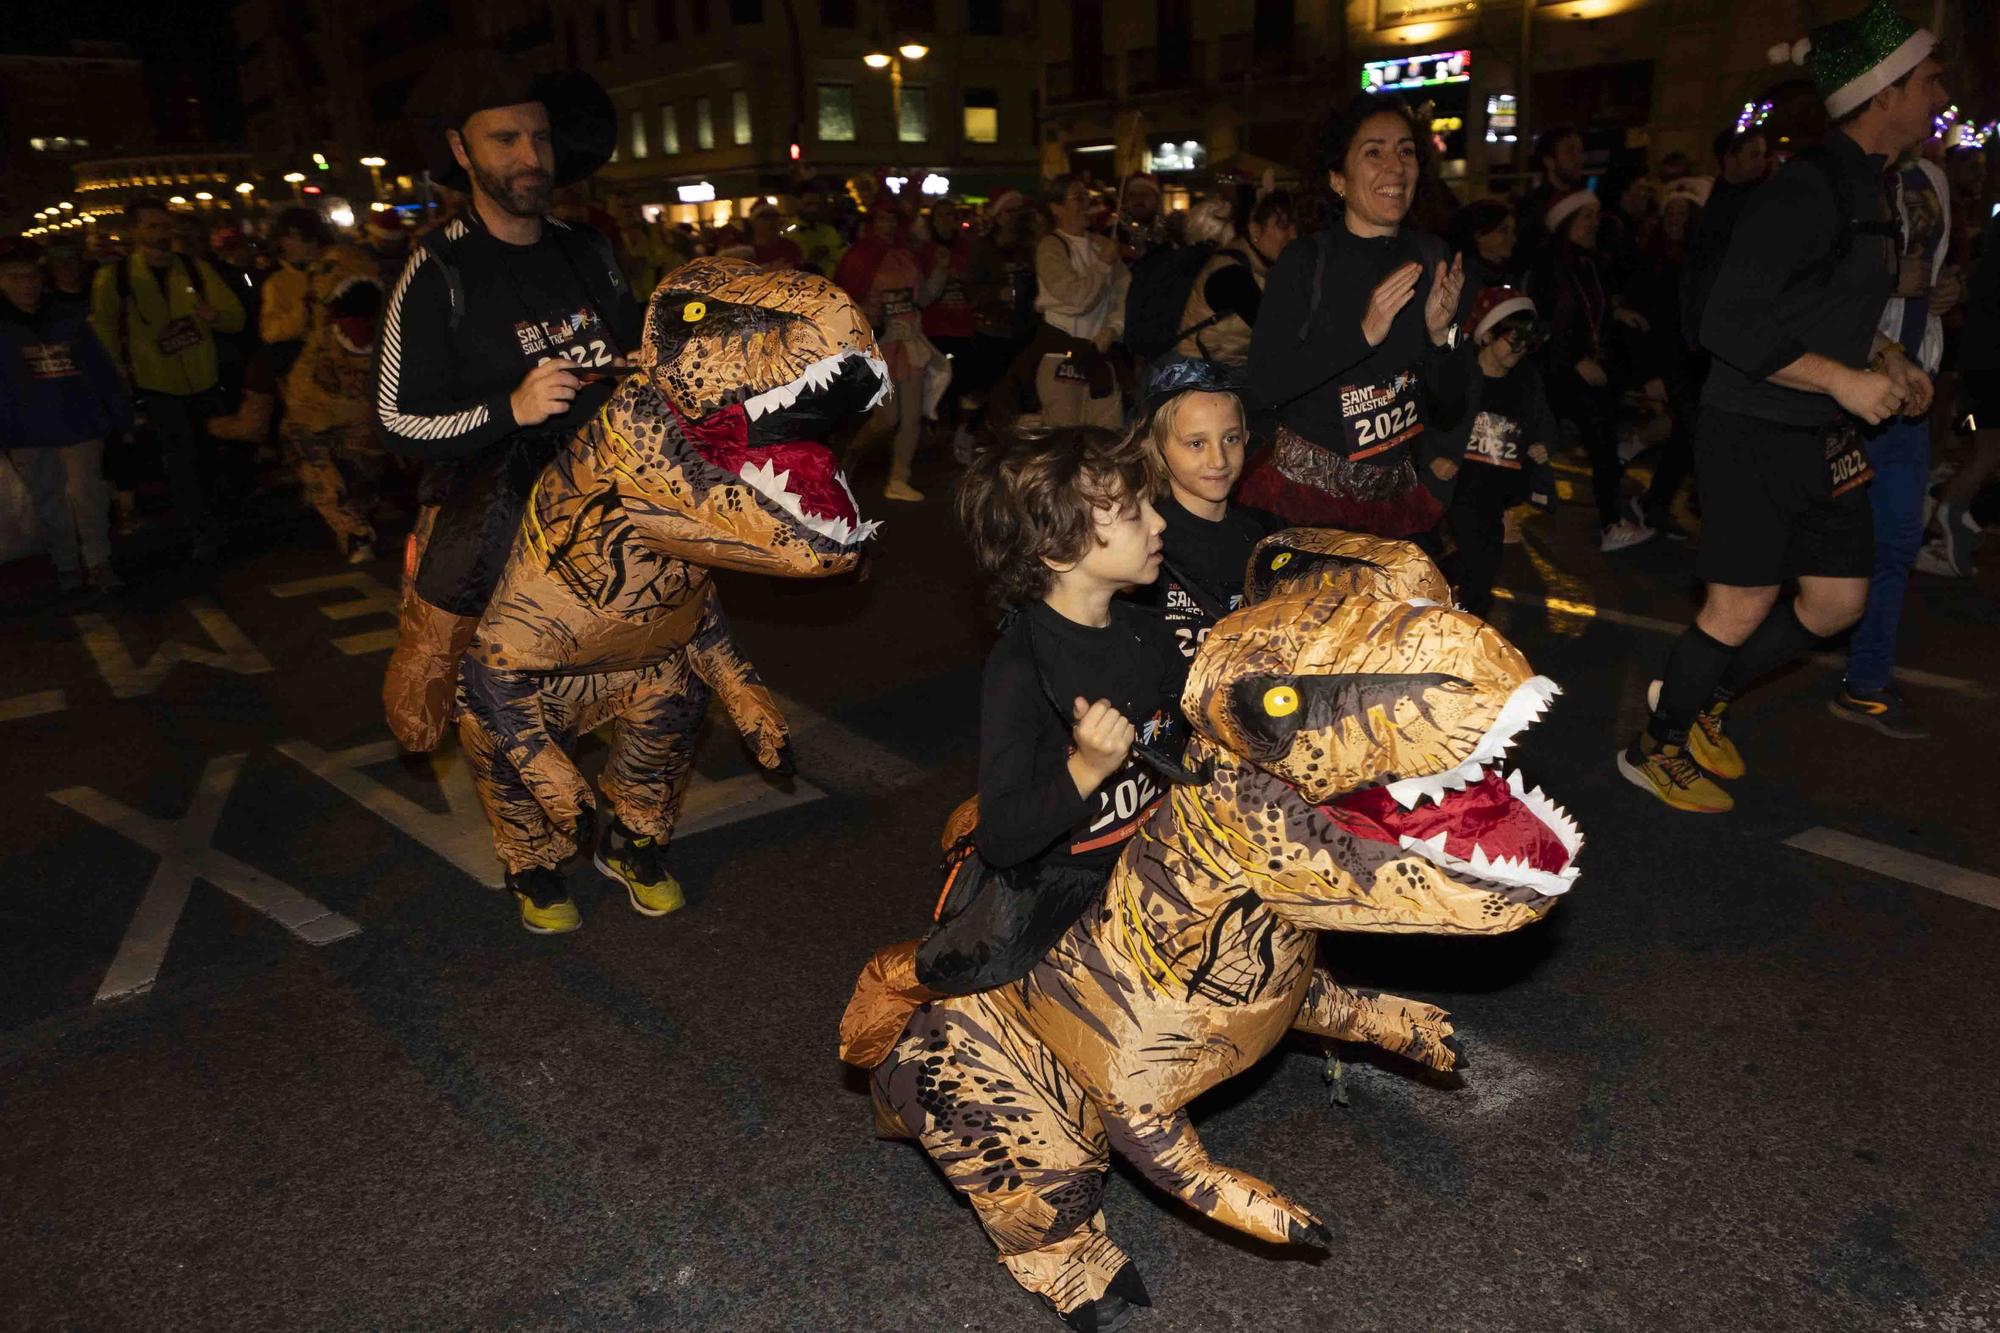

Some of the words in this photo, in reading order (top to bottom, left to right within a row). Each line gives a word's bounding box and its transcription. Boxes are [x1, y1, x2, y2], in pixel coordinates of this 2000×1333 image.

[1341, 385, 1376, 407] SANT
[1355, 401, 1418, 447] 2022
[1466, 435, 1518, 460] 2022
[1830, 449, 1868, 486] 2022
[1089, 771, 1163, 833] 202
